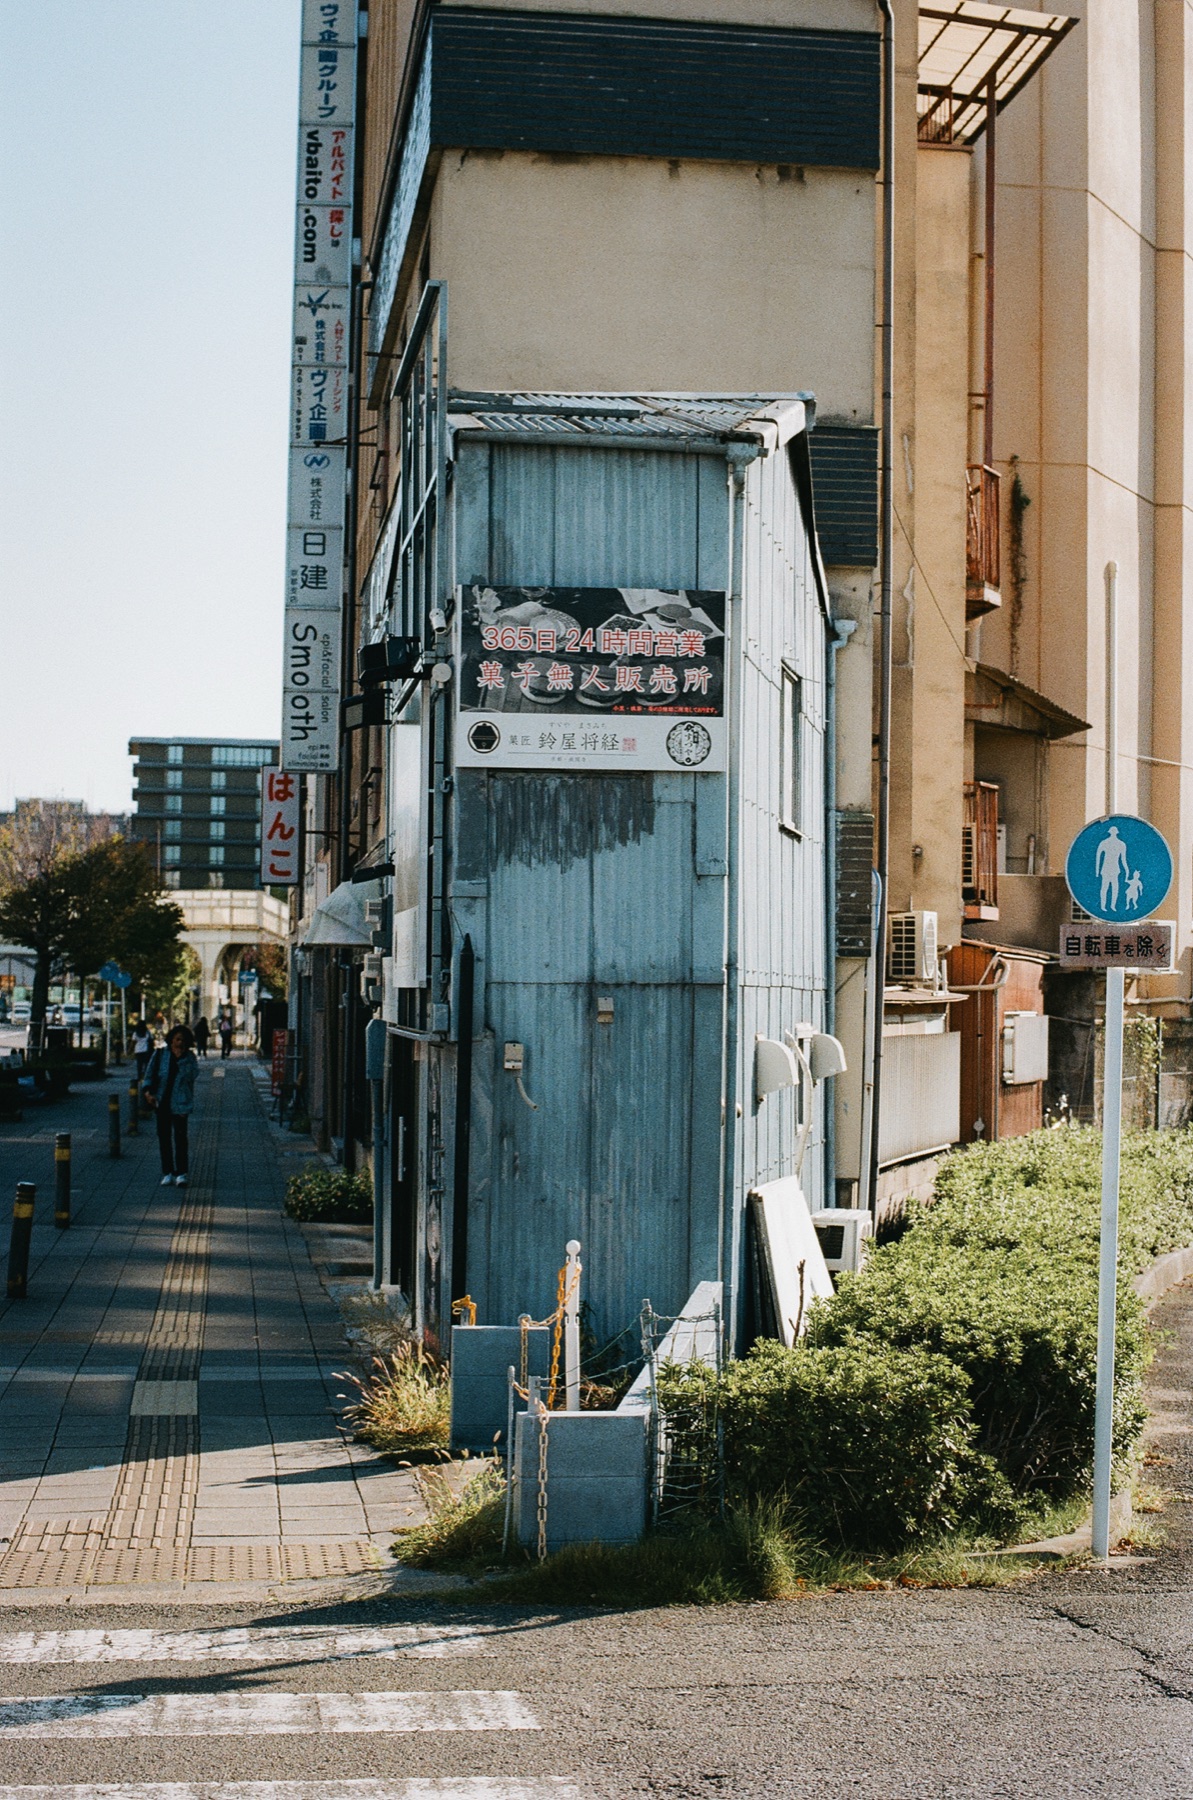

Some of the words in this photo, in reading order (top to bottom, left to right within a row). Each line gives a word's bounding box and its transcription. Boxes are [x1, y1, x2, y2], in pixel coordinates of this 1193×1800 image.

[310, 477, 323, 521] 株式会社
[299, 532, 328, 591] 日建
[482, 627, 557, 653] 365日
[565, 630, 706, 658] 24時間営業
[290, 622, 318, 741] Smooth
[477, 661, 713, 695] 菓子無人販売所
[321, 695, 331, 724] salon
[538, 732, 620, 751] 鈴屋将経
[267, 772, 296, 878] はんこ
[1065, 935, 1167, 958] 自転車を除く
